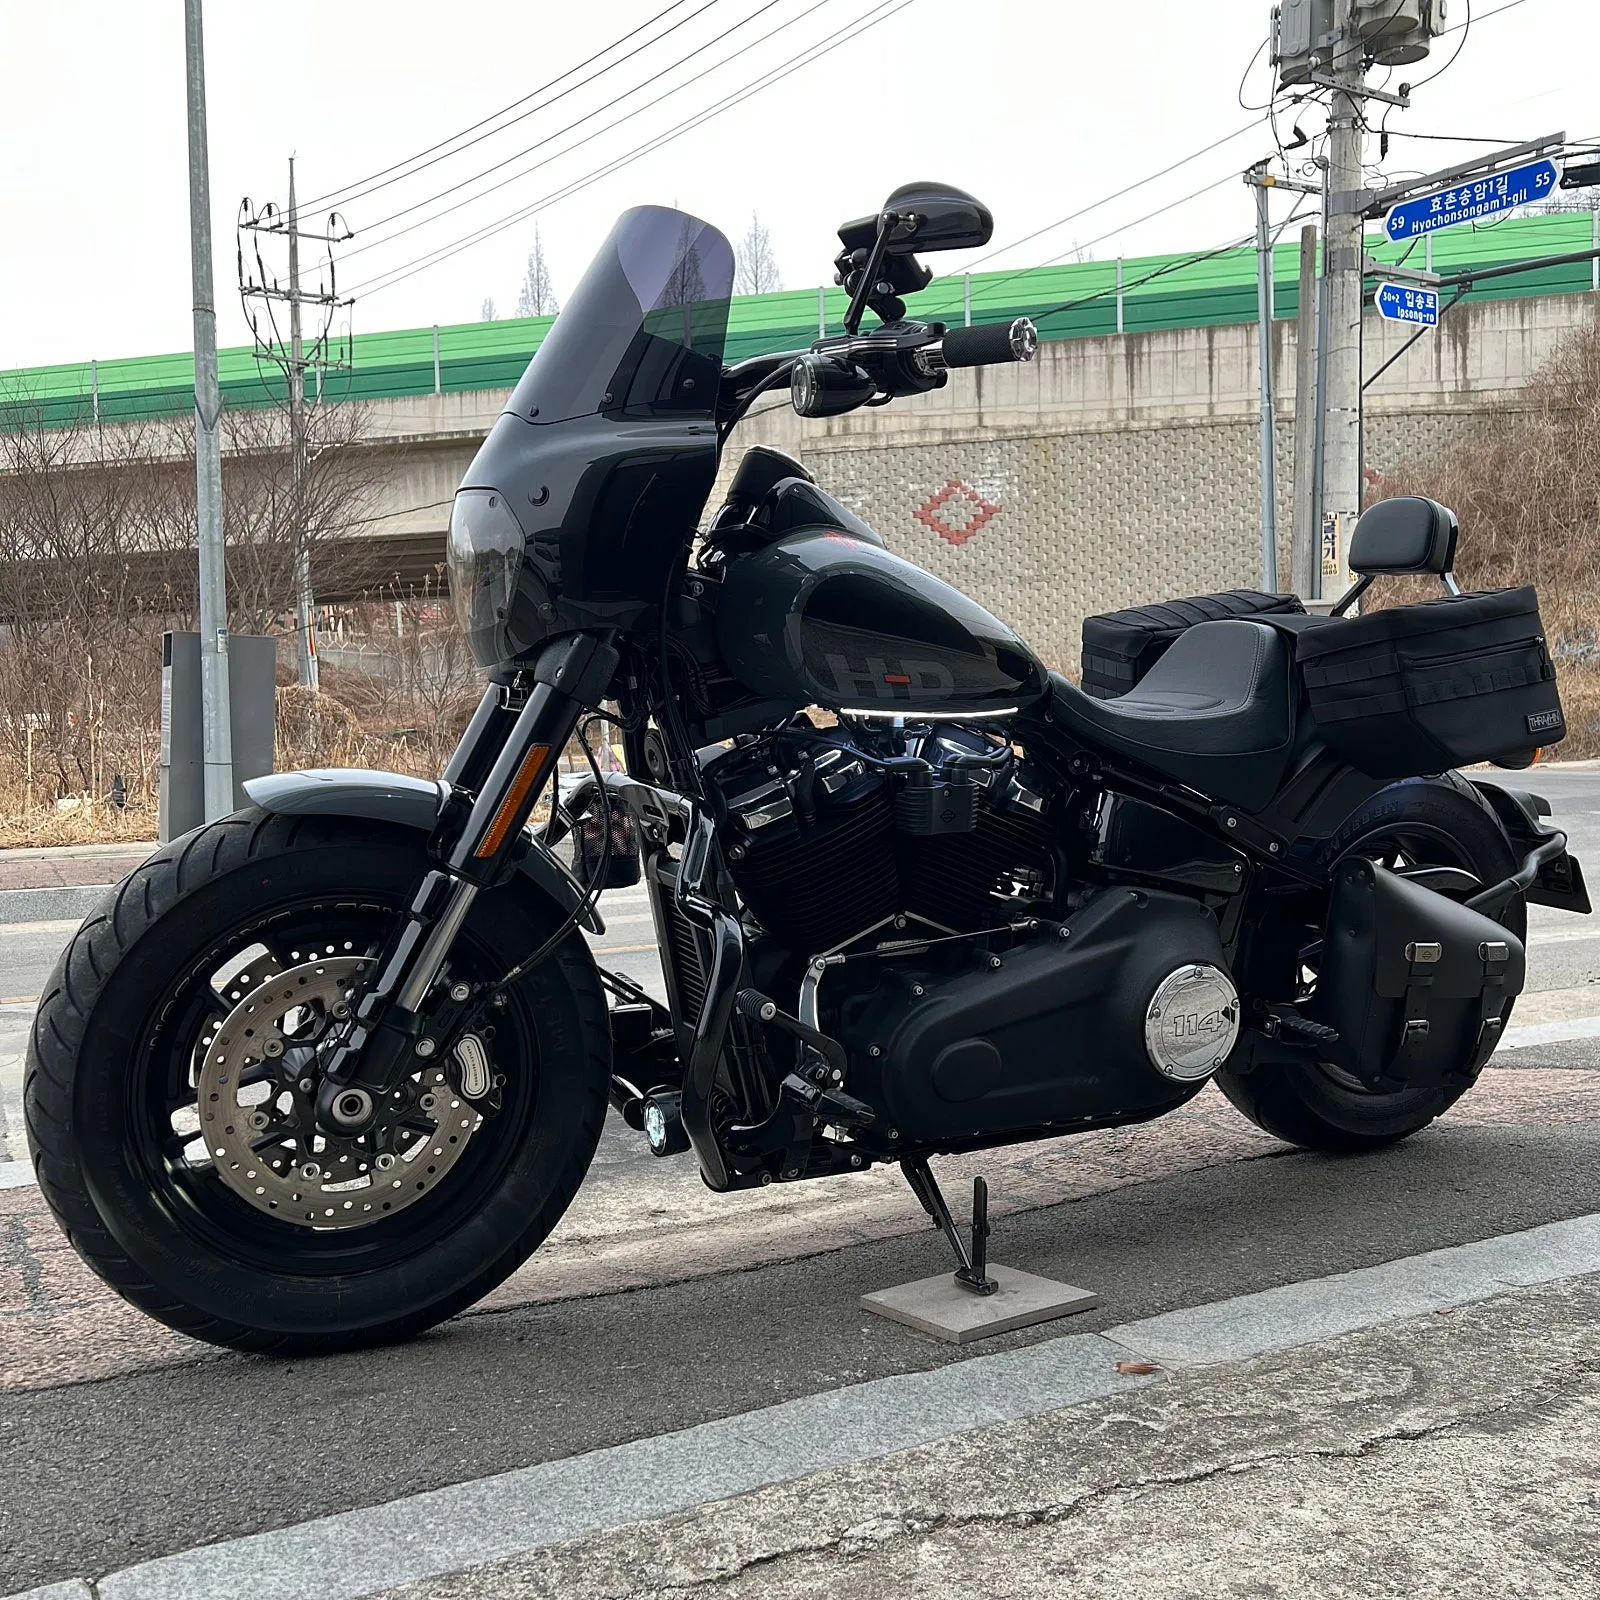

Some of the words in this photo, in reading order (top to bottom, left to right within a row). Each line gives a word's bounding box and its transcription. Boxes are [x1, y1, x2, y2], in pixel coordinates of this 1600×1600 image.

[1535, 171, 1550, 188] 55
[1429, 174, 1508, 213] 효촌송암1길
[1411, 198, 1500, 233] Hyochonsongam
[1502, 187, 1527, 207] 1-gil
[1391, 215, 1405, 231] 59
[1405, 290, 1435, 310] 입송로
[1397, 305, 1435, 323] Ipsong-ro
[824, 653, 955, 700] H-D
[1173, 1010, 1224, 1037] 114
